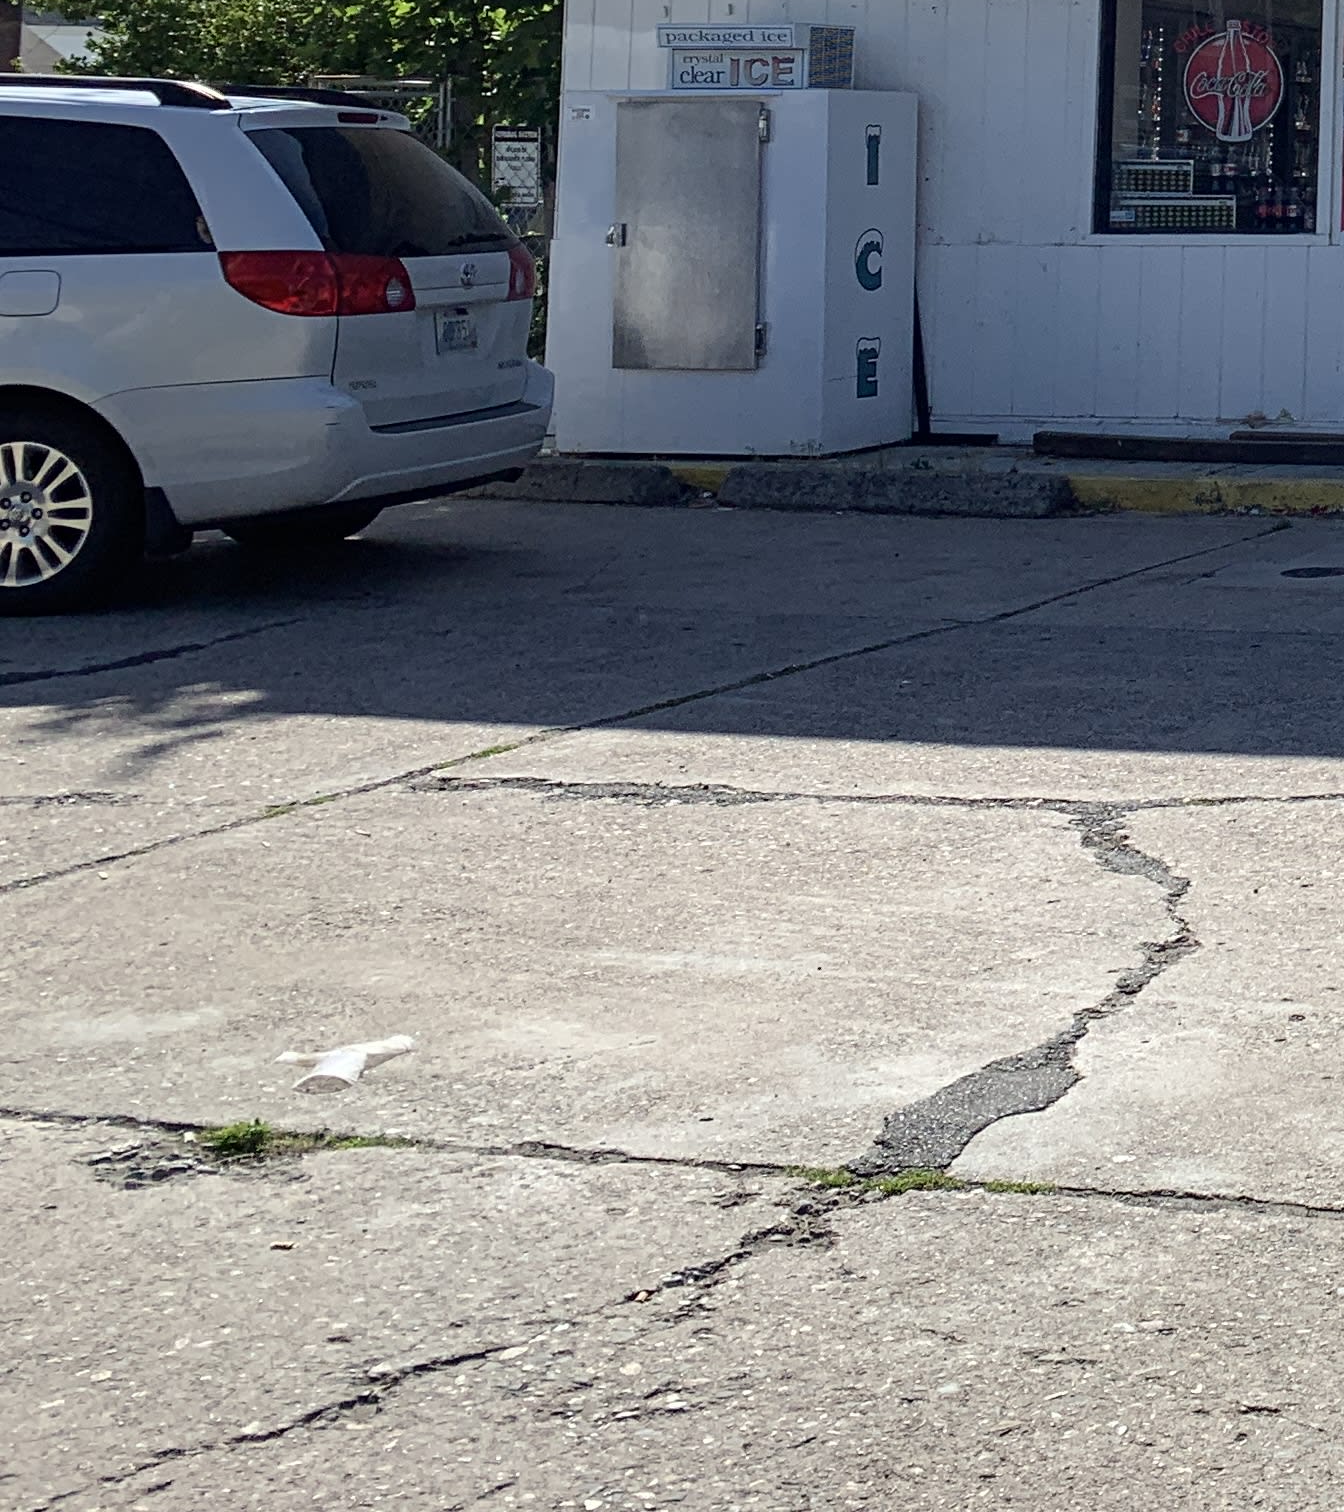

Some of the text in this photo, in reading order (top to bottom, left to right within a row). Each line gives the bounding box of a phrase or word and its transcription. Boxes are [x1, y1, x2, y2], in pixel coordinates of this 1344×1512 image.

[665, 30, 787, 44] packaged ice
[683, 53, 723, 65] crystal
[680, 56, 795, 87] clear ICE
